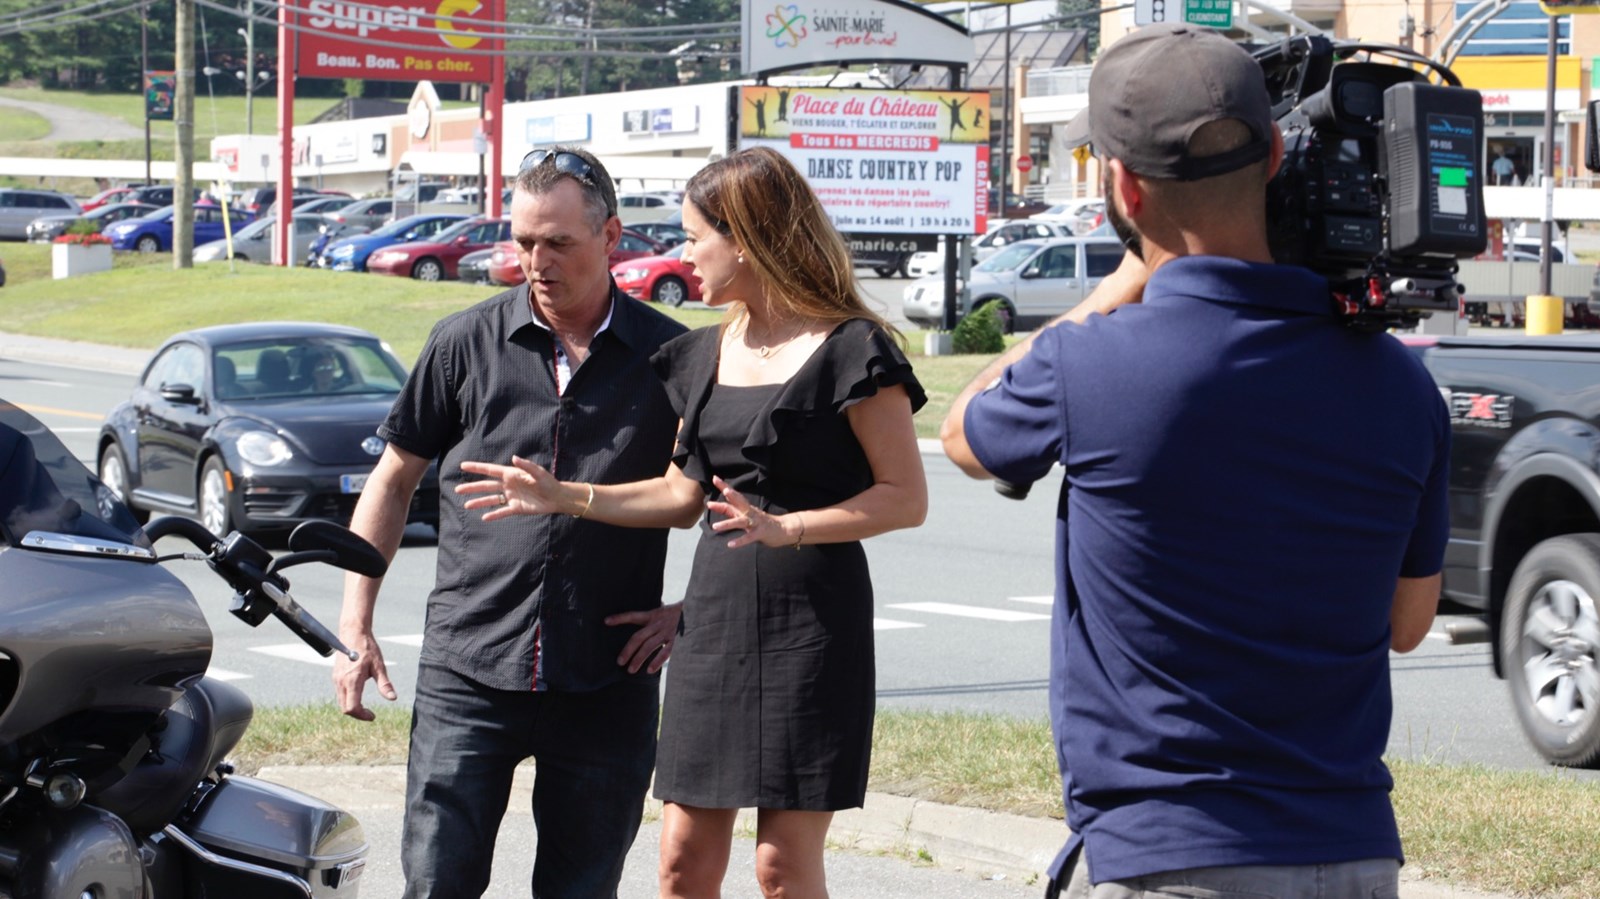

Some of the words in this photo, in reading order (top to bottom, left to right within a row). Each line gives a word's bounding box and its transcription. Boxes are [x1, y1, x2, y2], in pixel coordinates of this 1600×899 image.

[436, 0, 483, 49] C
[813, 16, 885, 33] SAINTE-MARIE
[317, 52, 362, 68] Beau.
[365, 54, 401, 70] Bon.
[404, 56, 433, 71] Pas
[436, 57, 475, 72] cher.
[792, 94, 840, 115] Place
[842, 96, 866, 116] du
[869, 95, 938, 117] Château
[791, 118, 814, 127] VIENS
[889, 120, 898, 129] ET
[900, 121, 937, 130] EXPLORER
[802, 134, 832, 148] Tous
[833, 135, 854, 148] les
[856, 135, 931, 149] MERCREDIS
[808, 158, 853, 179] DANSE
[860, 160, 929, 182] COUNTRY
[935, 161, 962, 182] POP
[864, 187, 895, 196] danses
[912, 188, 931, 198] plus
[976, 160, 987, 217] GRATUIT
[868, 198, 912, 209] répertoire
[835, 215, 853, 227] juin
[856, 217, 867, 226] au
[870, 215, 882, 226] 14
[884, 215, 905, 227] août
[920, 217, 932, 227] 19
[934, 217, 941, 227] h
[950, 217, 963, 227] 20
[964, 217, 971, 227] h
[845, 237, 918, 252] -marie.ca
